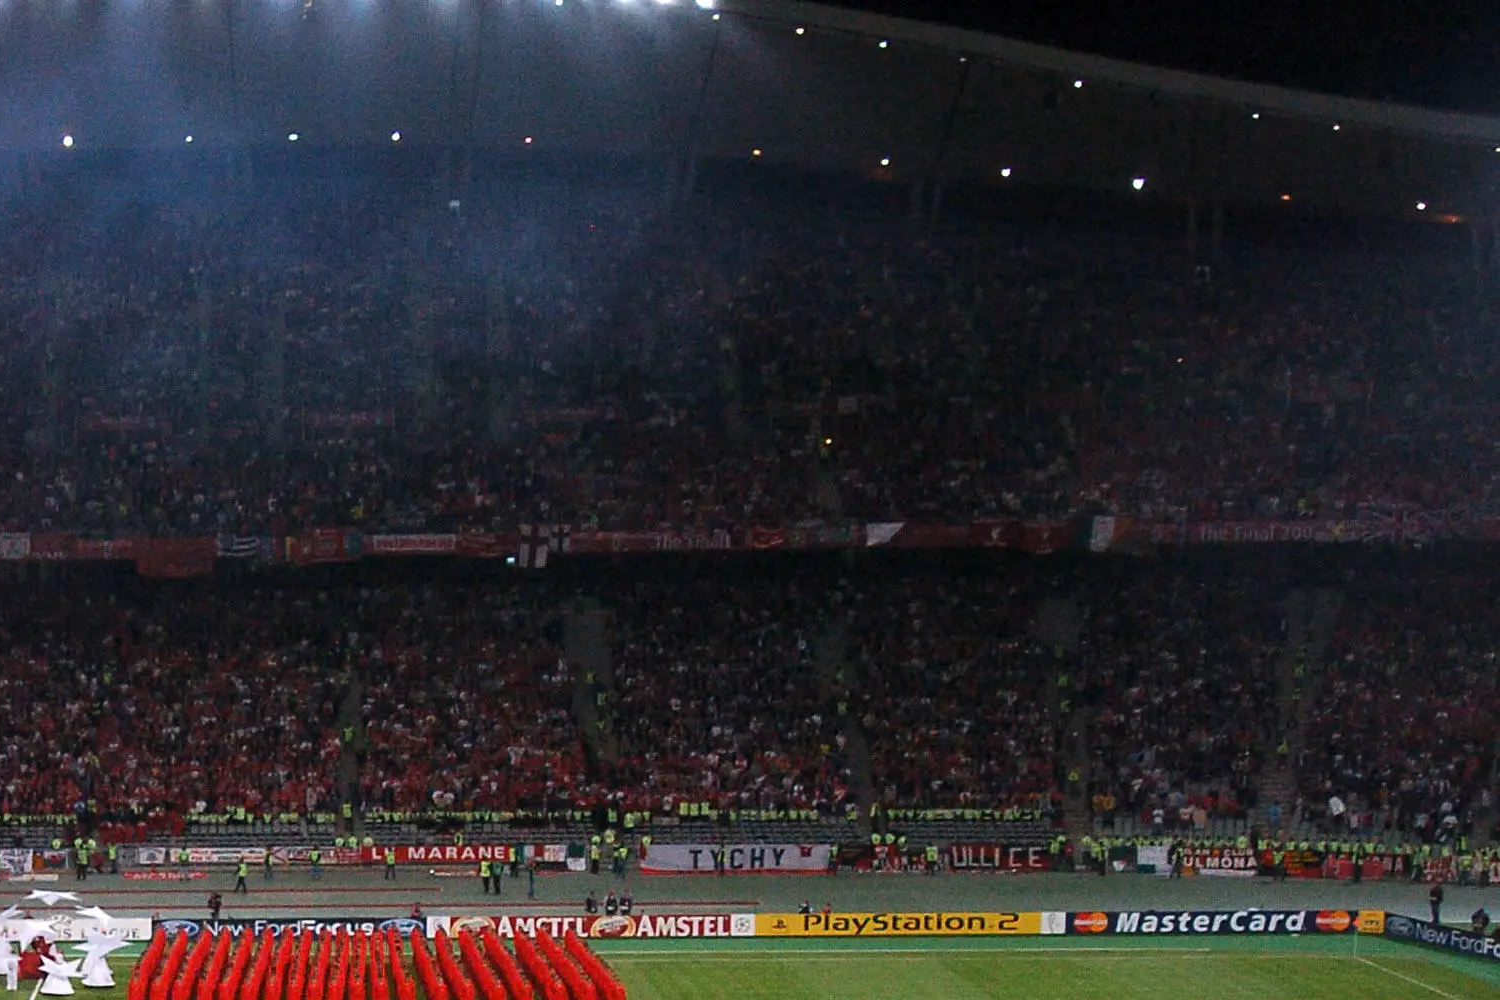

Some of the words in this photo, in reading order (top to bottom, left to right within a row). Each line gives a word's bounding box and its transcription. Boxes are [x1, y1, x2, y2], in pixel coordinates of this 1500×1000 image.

[408, 846, 505, 860] MARANE
[203, 920, 244, 937] Nw
[636, 914, 730, 938] AMSTEL
[803, 913, 985, 936] PlayStation
[998, 912, 1019, 931] 2
[1115, 910, 1307, 933] MasterCard
[1415, 921, 1448, 945] New
